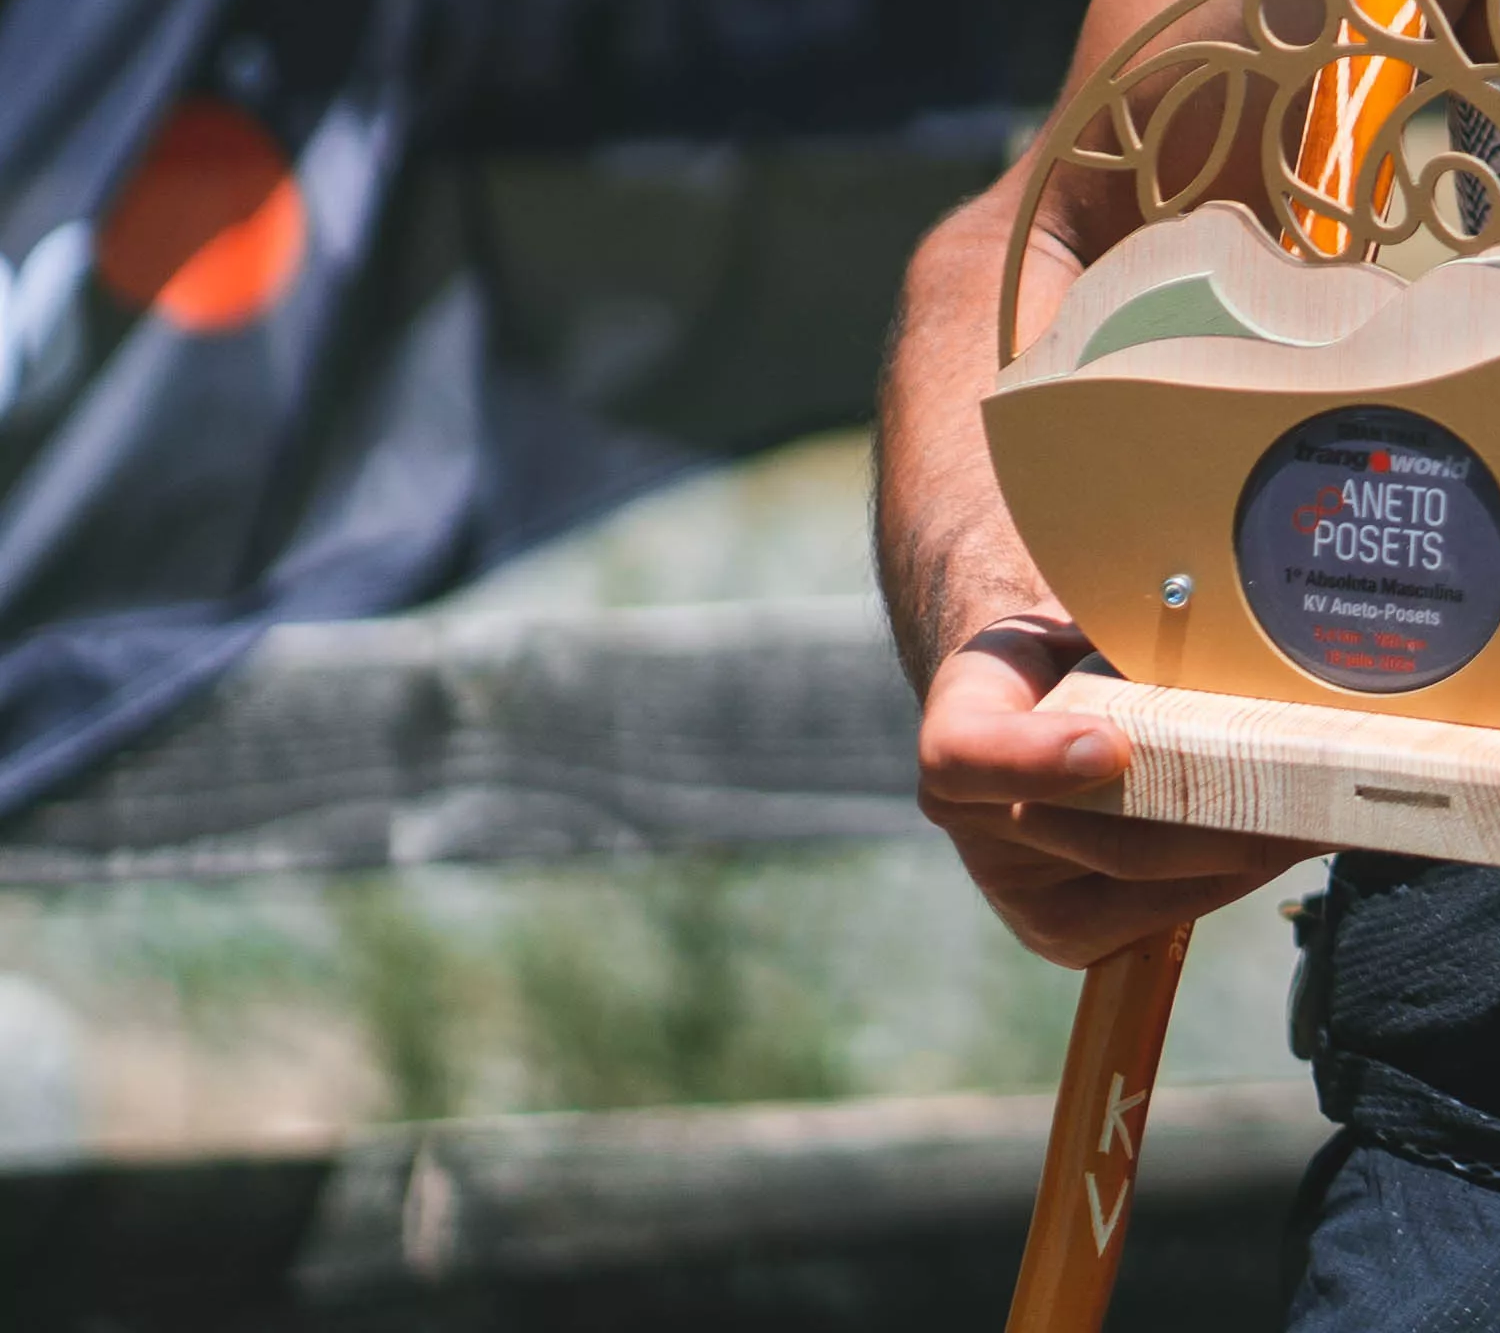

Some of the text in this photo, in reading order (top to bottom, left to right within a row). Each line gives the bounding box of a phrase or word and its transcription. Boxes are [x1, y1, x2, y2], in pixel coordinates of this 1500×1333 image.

[1341, 478, 1448, 527] ANETO
[1313, 520, 1444, 571] POSETS
[1303, 594, 1441, 626] KV Aneto-Posets
